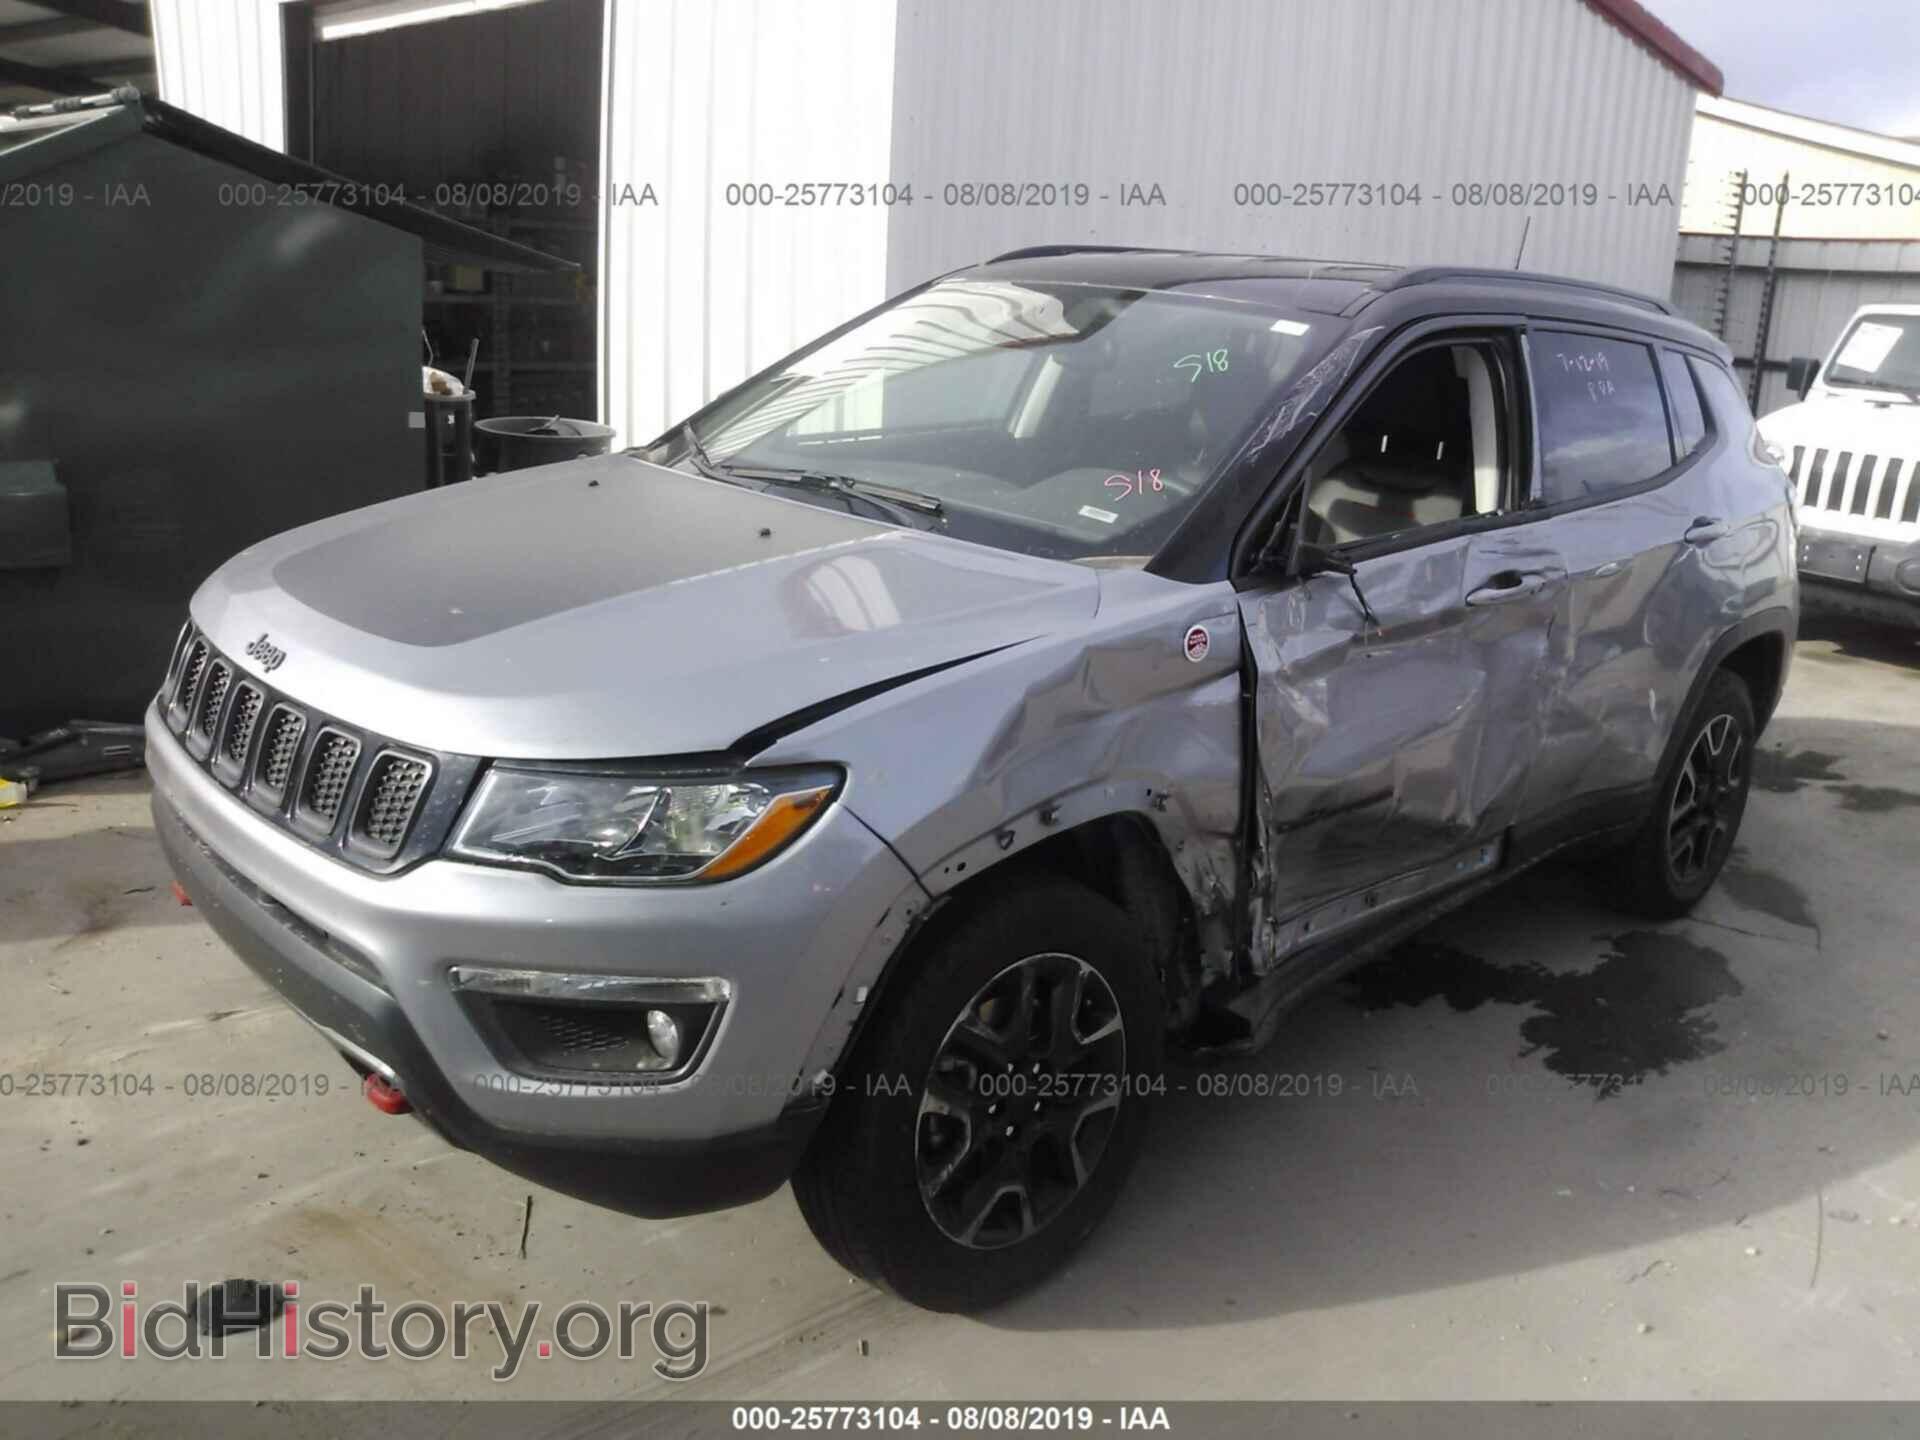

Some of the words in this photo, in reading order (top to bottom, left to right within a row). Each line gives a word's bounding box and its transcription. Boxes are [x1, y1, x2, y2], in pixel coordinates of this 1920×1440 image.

[1173, 348, 1229, 383] S18
[1103, 468, 1163, 502] S18
[246, 633, 287, 674] Jeep
